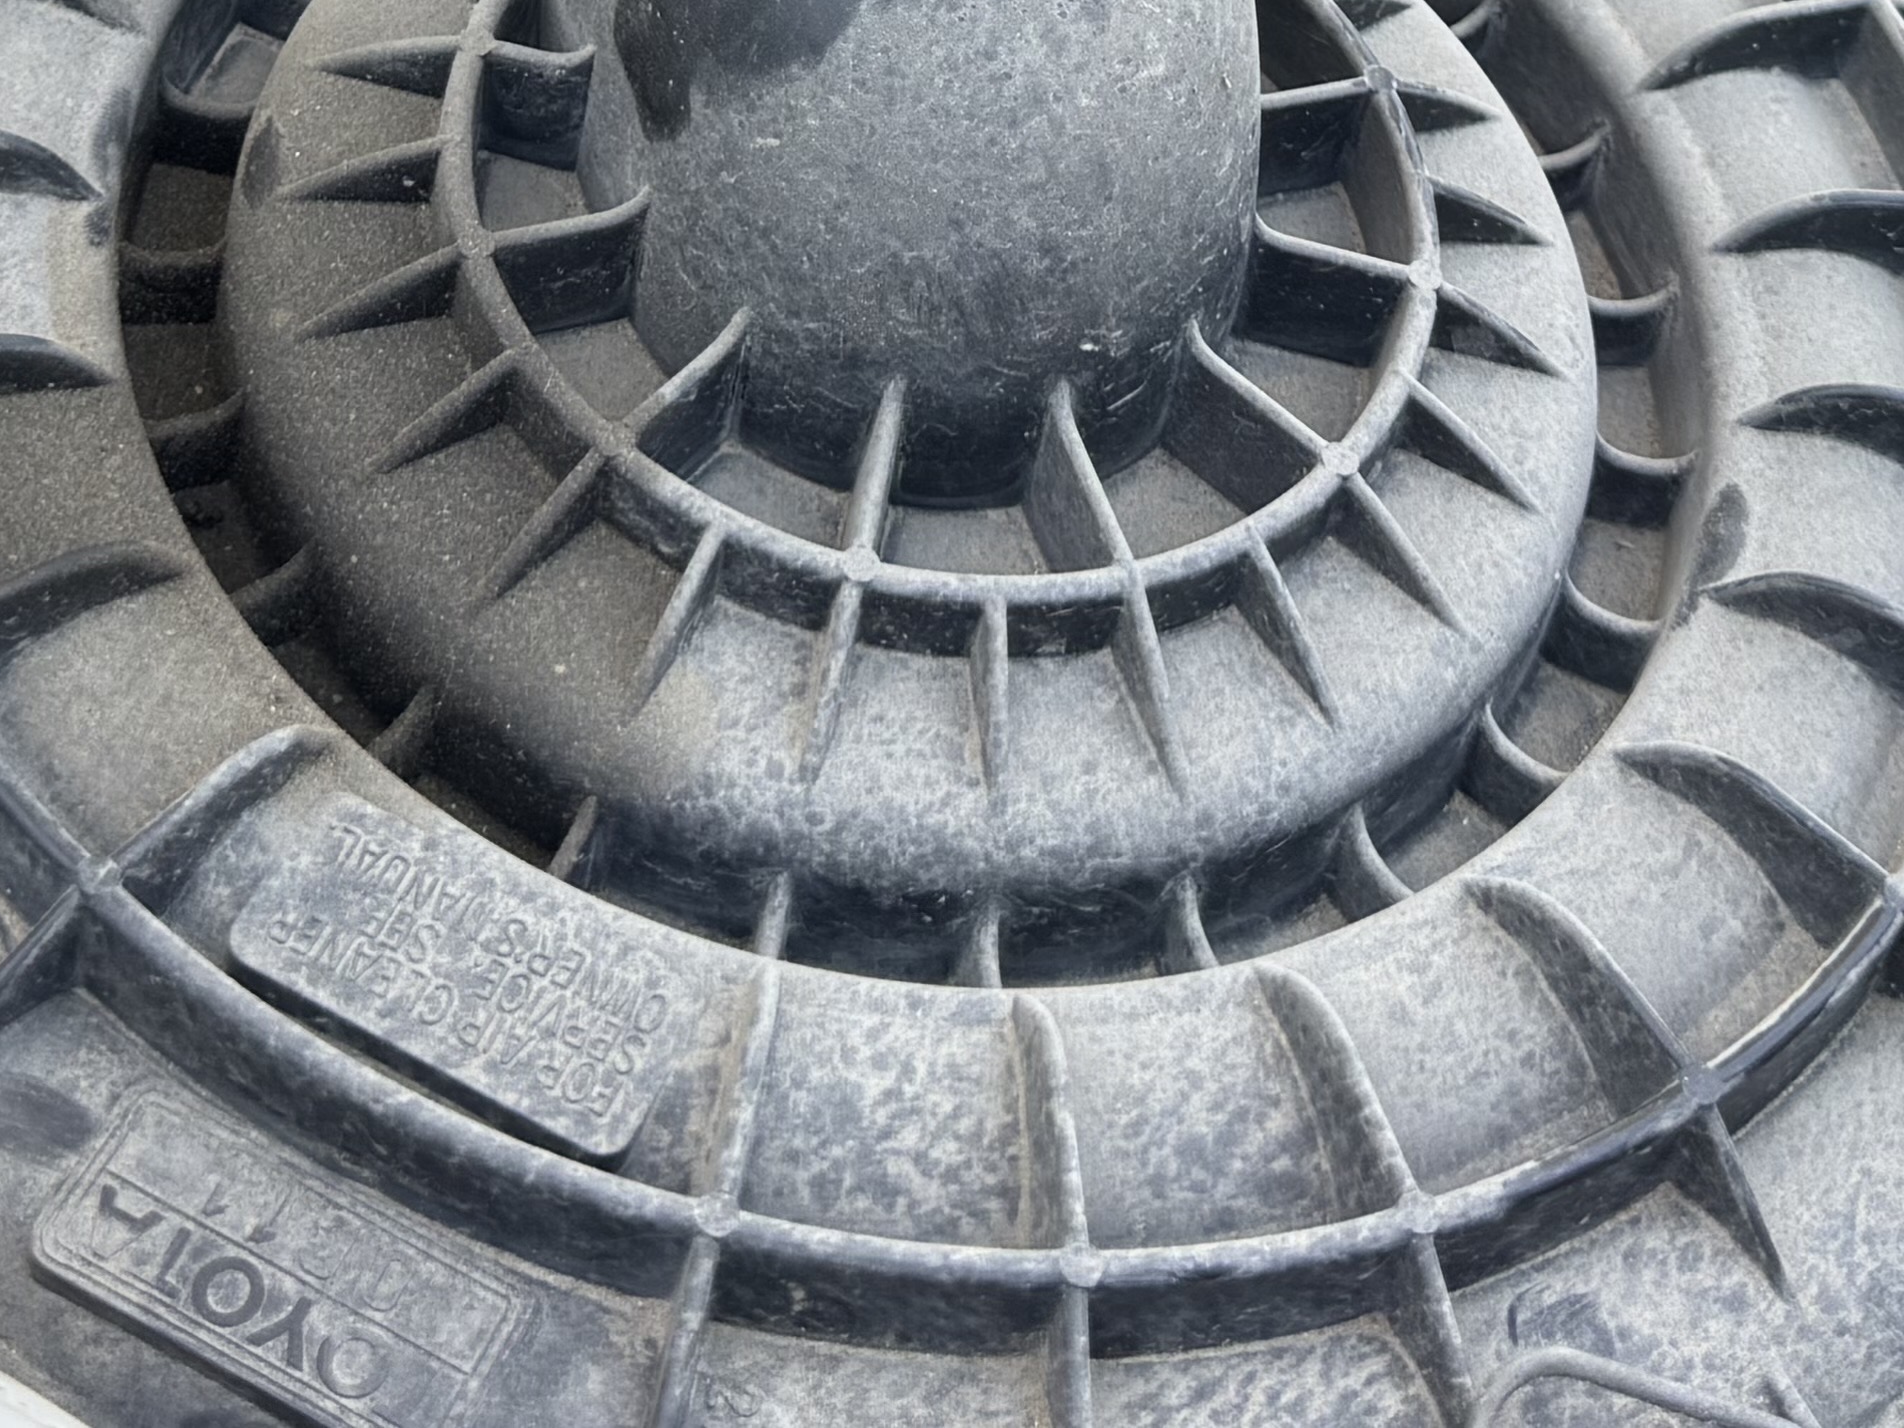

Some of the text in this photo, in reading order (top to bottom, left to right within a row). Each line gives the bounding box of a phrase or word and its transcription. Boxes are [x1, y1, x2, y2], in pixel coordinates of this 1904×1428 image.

[361, 897, 442, 964] SEE
[267, 906, 626, 1117] FOR AIR CLEANER
